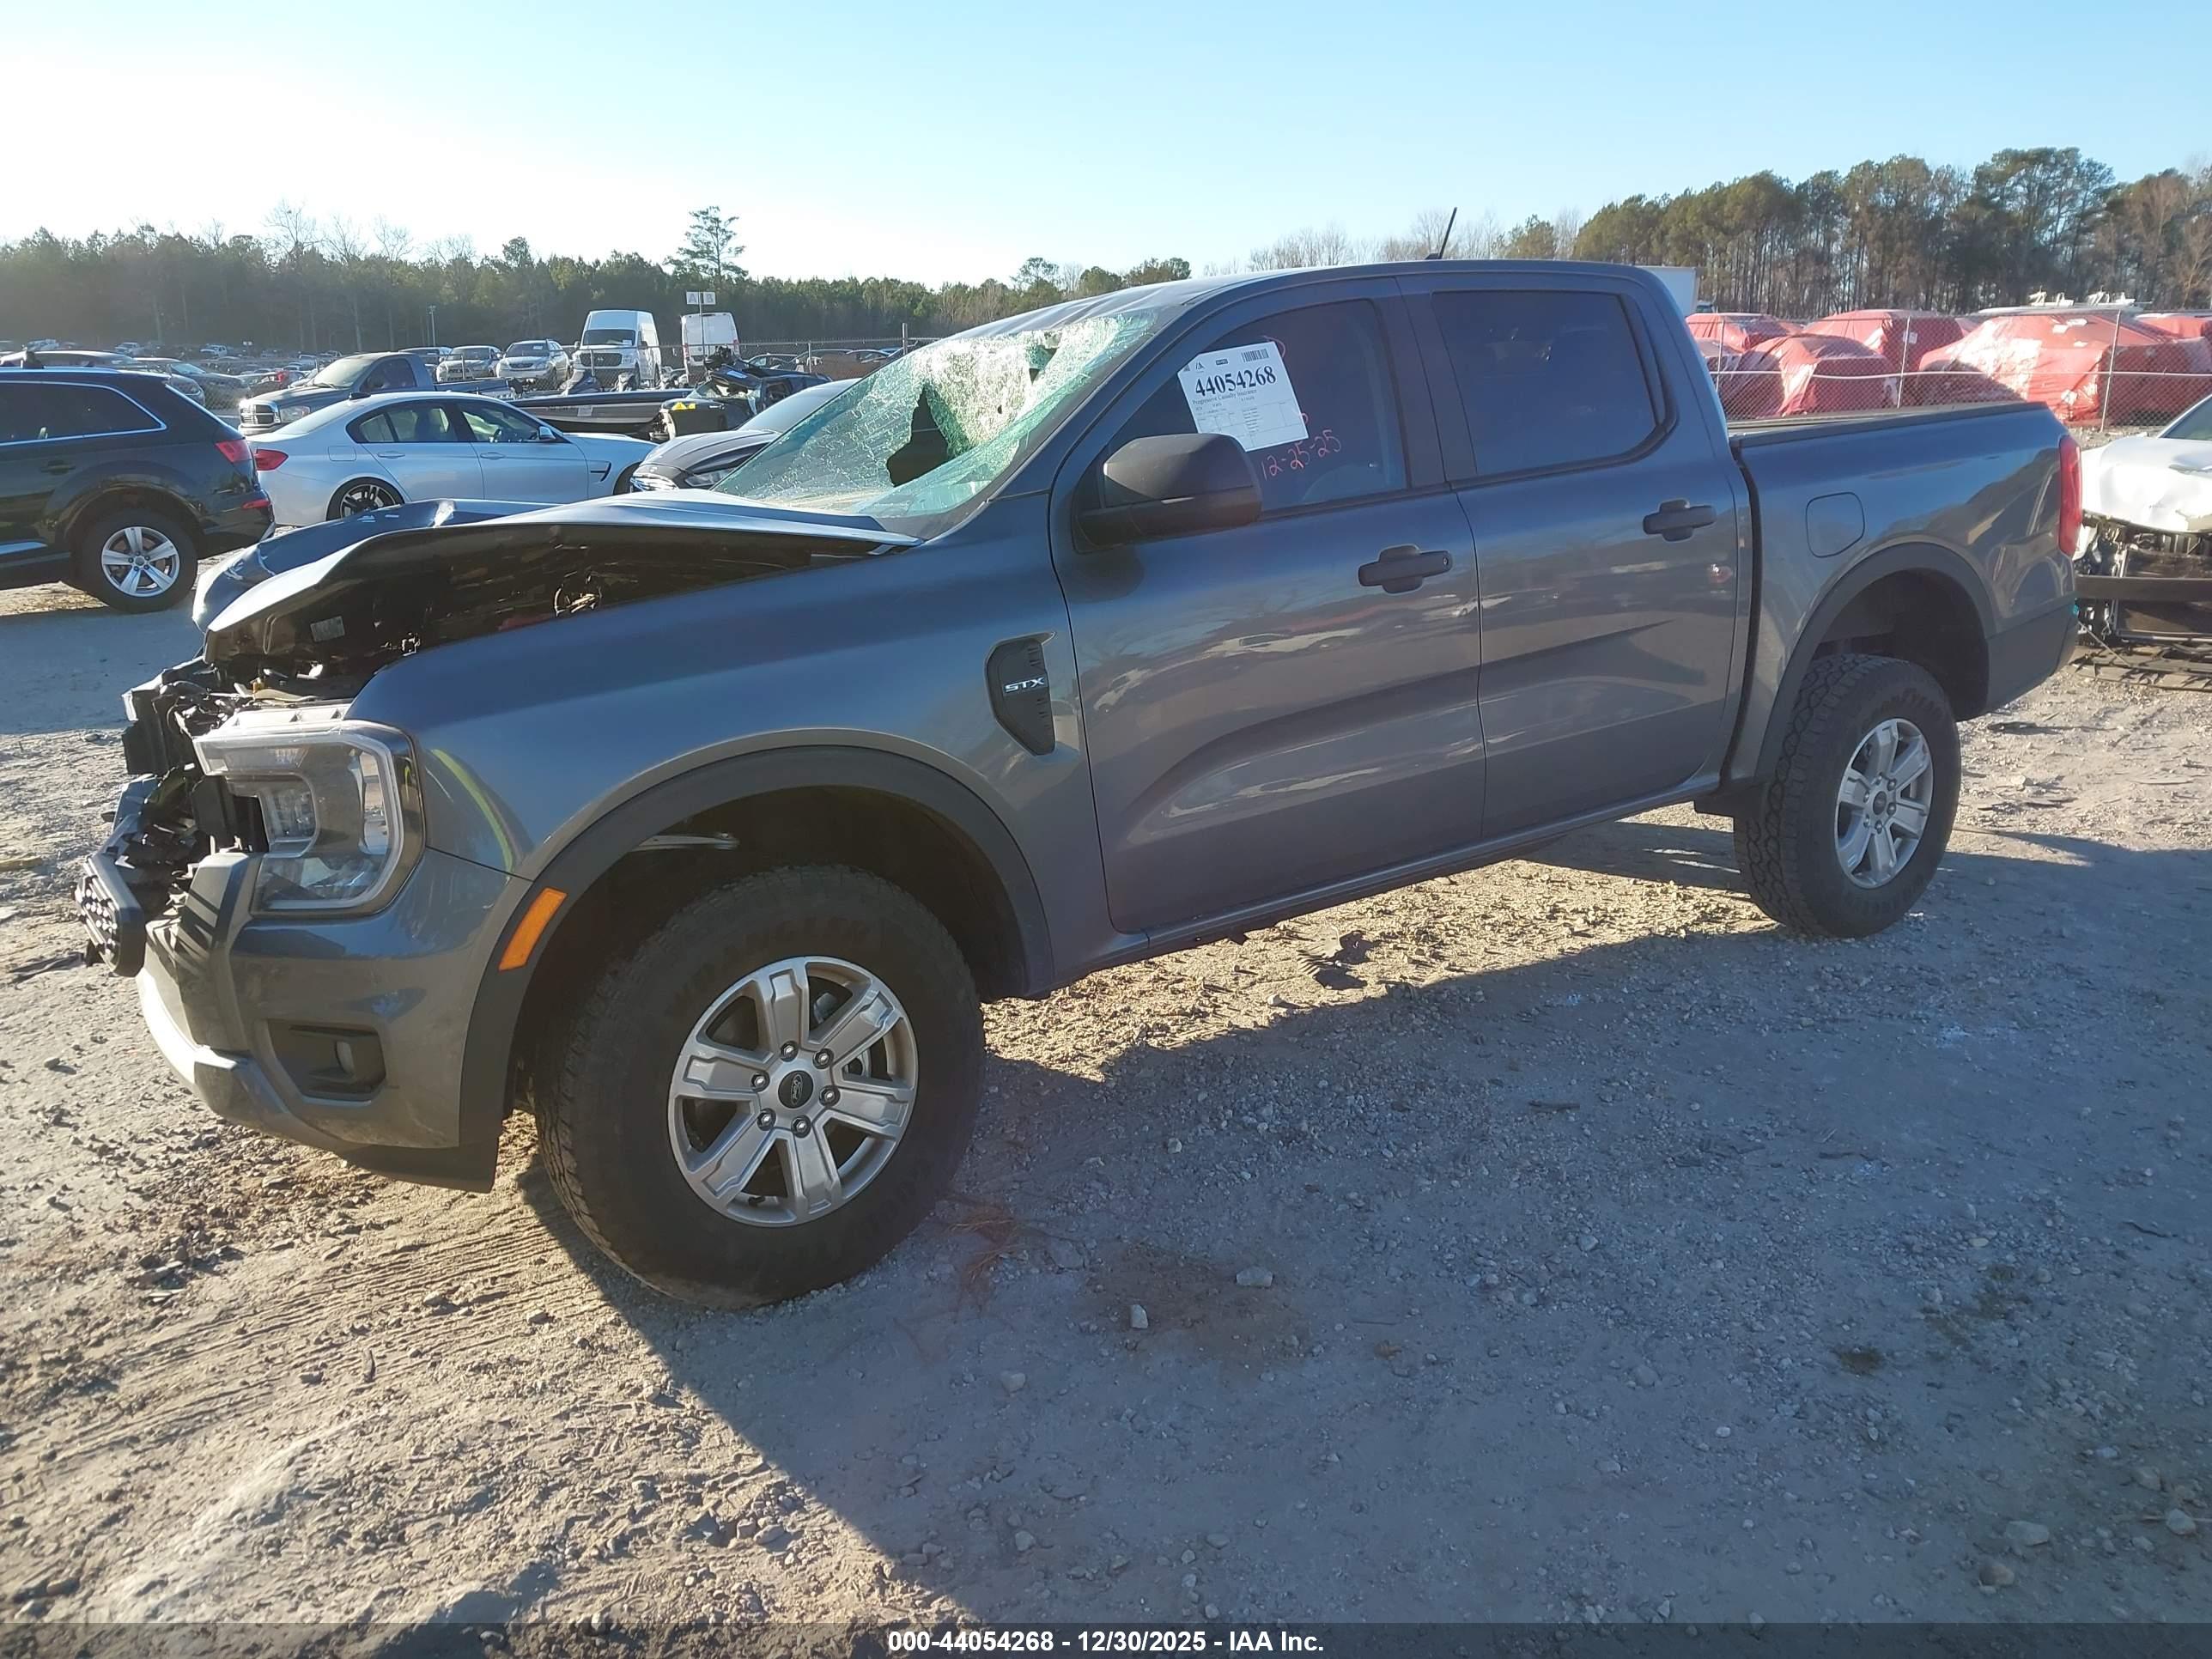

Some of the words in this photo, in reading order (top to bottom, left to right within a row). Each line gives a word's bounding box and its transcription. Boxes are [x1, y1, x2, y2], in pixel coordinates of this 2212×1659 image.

[1194, 365, 1277, 397] 44054268
[1261, 429, 1342, 481] 12-25-25
[1004, 676, 1045, 693] STX
